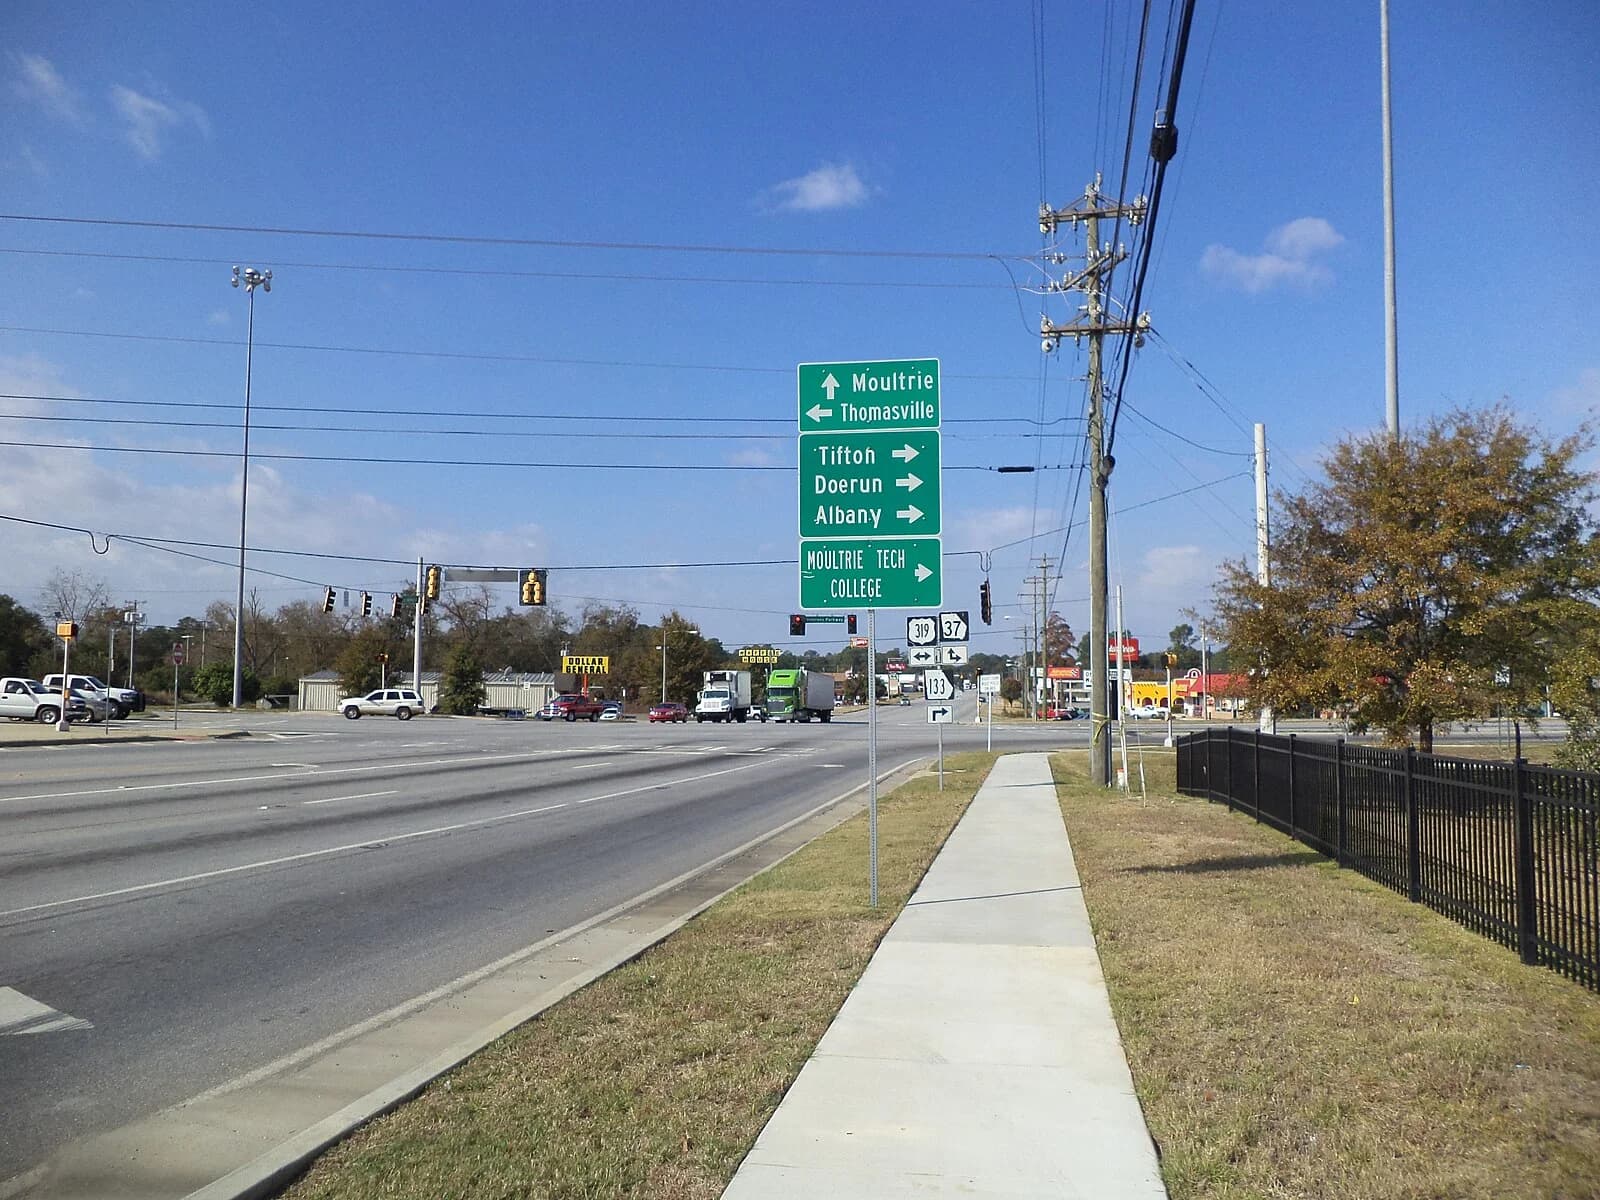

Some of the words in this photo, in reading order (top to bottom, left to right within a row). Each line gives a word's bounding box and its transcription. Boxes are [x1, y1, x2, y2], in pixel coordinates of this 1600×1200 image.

[852, 371, 934, 393] Moultrie
[840, 401, 934, 423] Thomasville
[818, 446, 876, 466] Tifton
[815, 474, 882, 495] Doerun
[815, 505, 881, 529] Albany
[807, 550, 864, 571] MOULTRIE
[877, 549, 905, 569] TECH
[830, 579, 882, 598] COLLEGE
[915, 623, 930, 638] 319
[944, 620, 961, 637] 37
[566, 665, 606, 674] GENERAL
[568, 657, 603, 665] DOLLAR
[929, 678, 946, 695] 133
